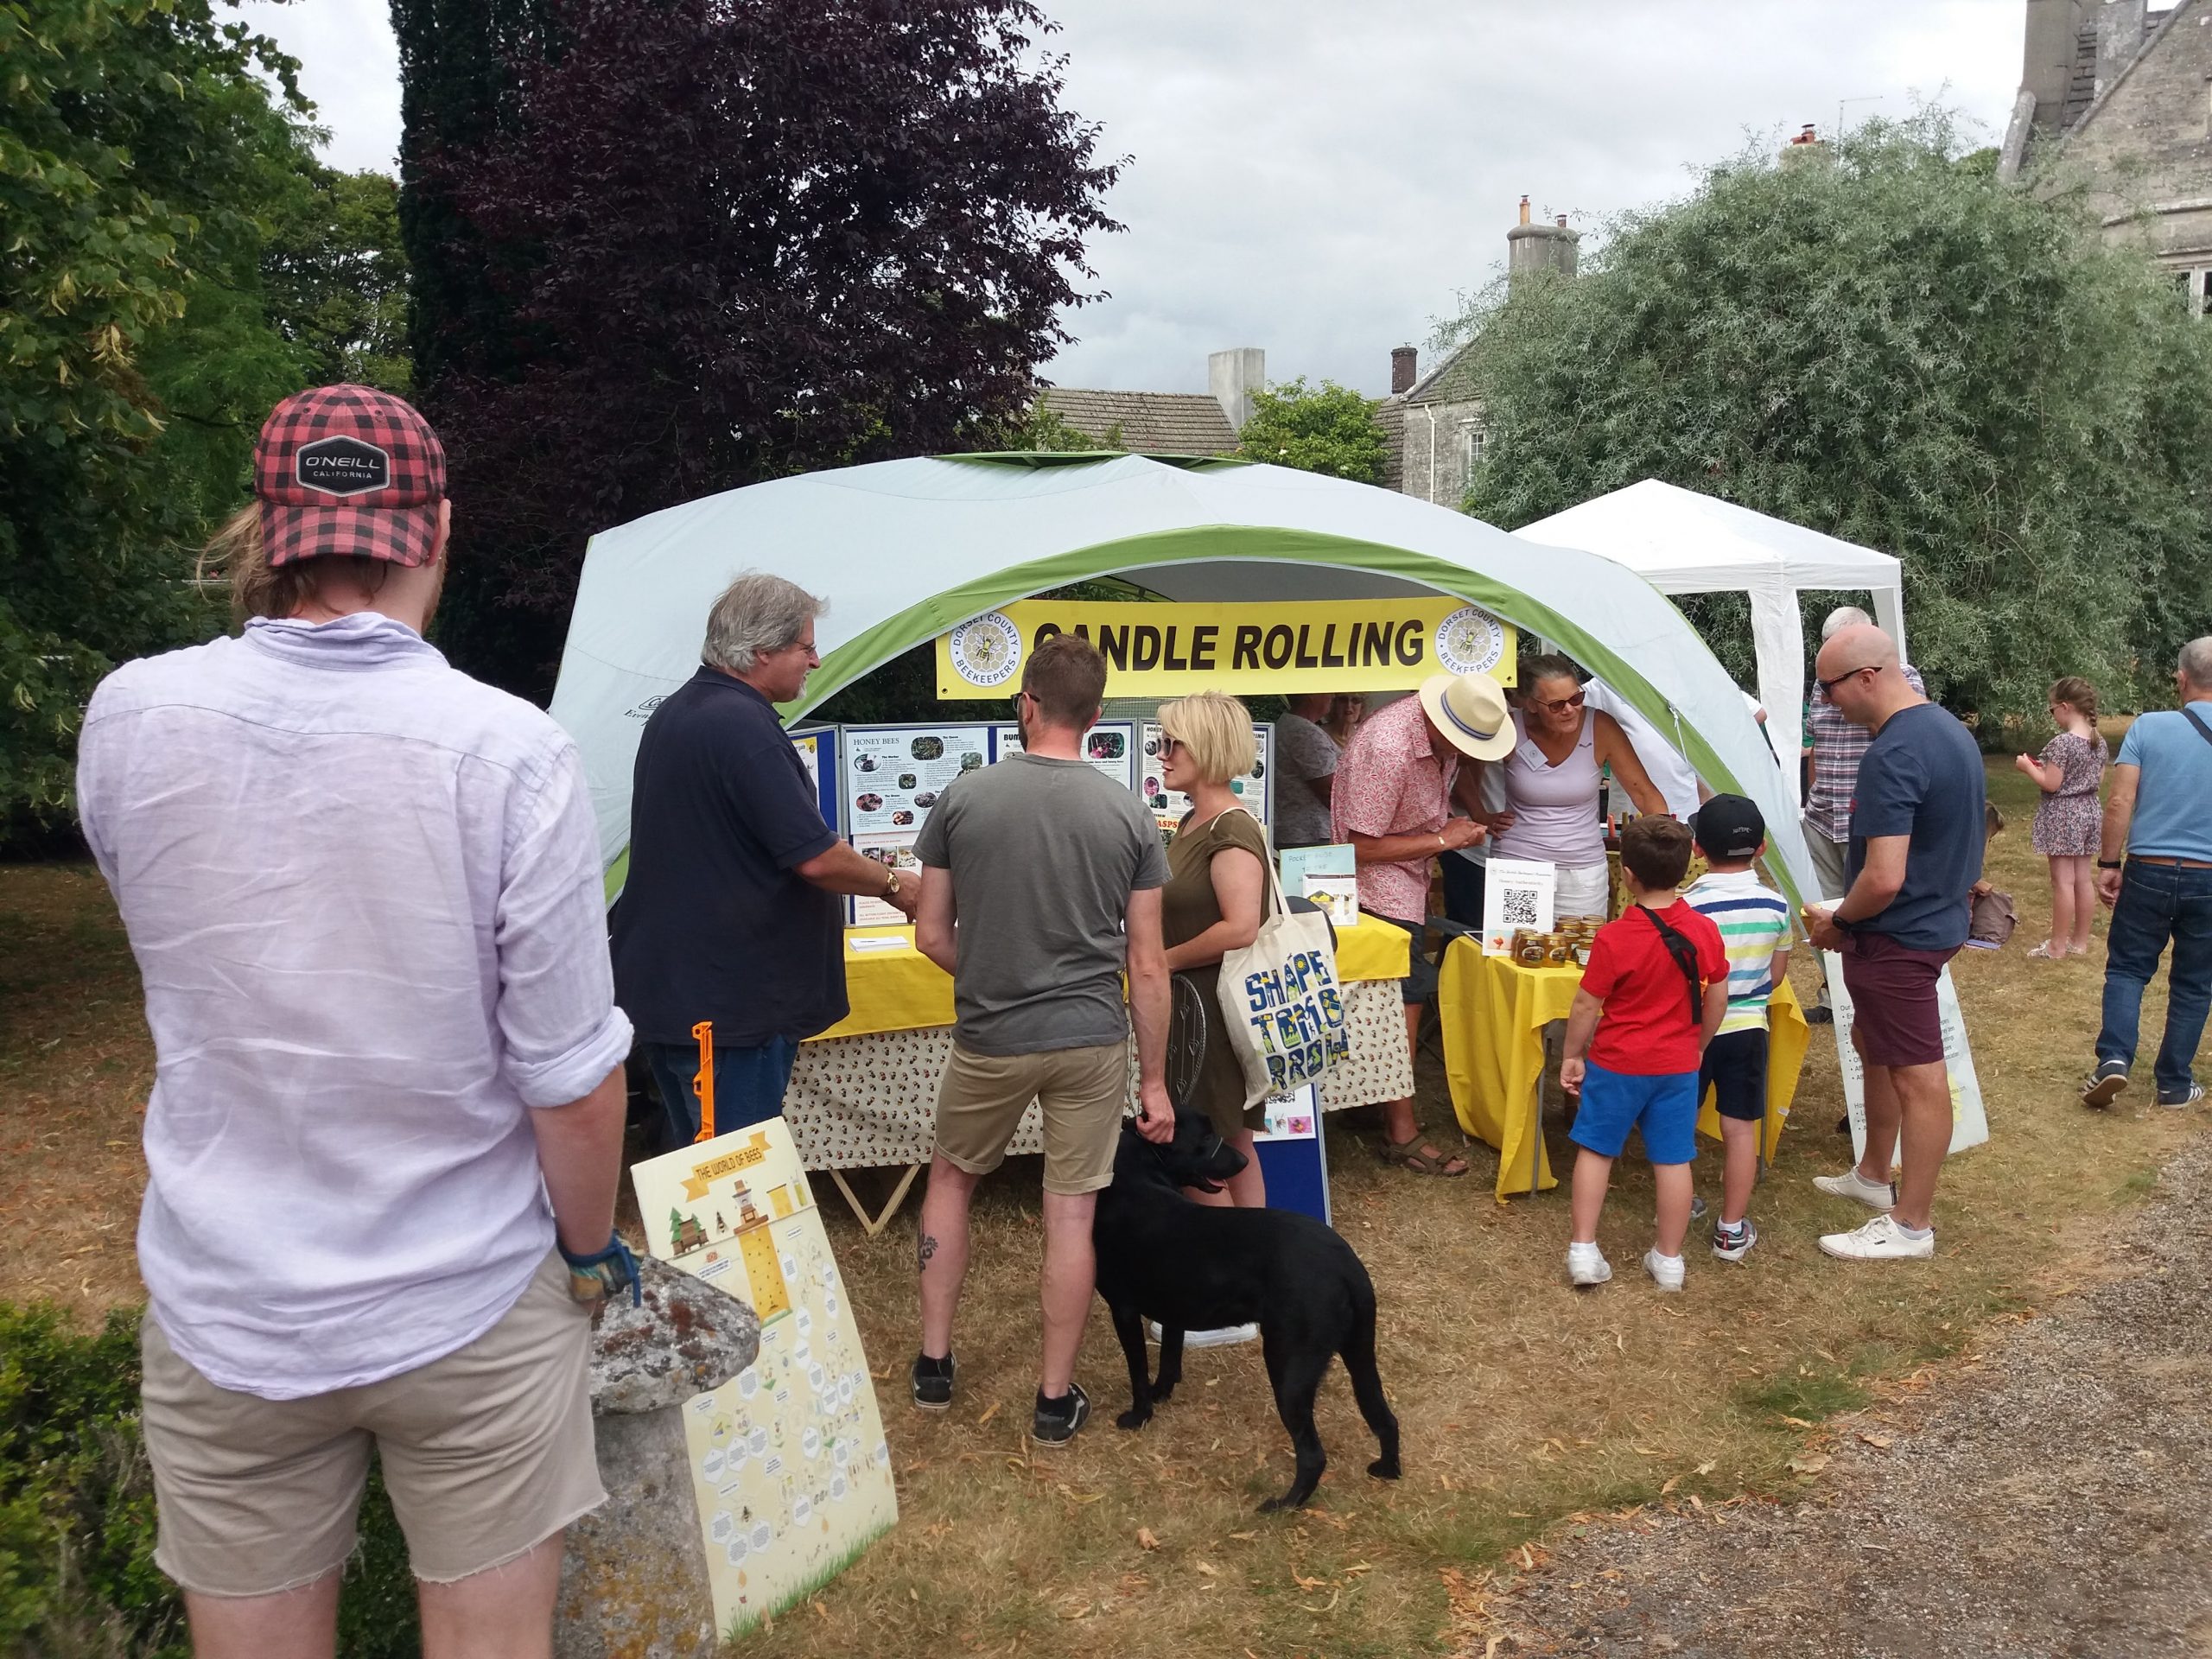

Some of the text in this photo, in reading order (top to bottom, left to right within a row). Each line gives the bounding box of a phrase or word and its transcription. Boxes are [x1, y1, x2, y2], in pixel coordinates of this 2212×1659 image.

[305, 456, 380, 469] O'NEILL
[313, 470, 372, 479] CALIFORNIA
[988, 613, 1019, 646] COUNTY
[1438, 608, 1501, 639] DORSET COUNTY
[1232, 619, 1424, 670] ROLLING
[956, 658, 1016, 683] BEEKEEPERS
[1157, 820, 1178, 829] ASPS
[1244, 950, 1332, 1012] SHAPE
[696, 1147, 762, 1181] THE WORLD OF BEES
